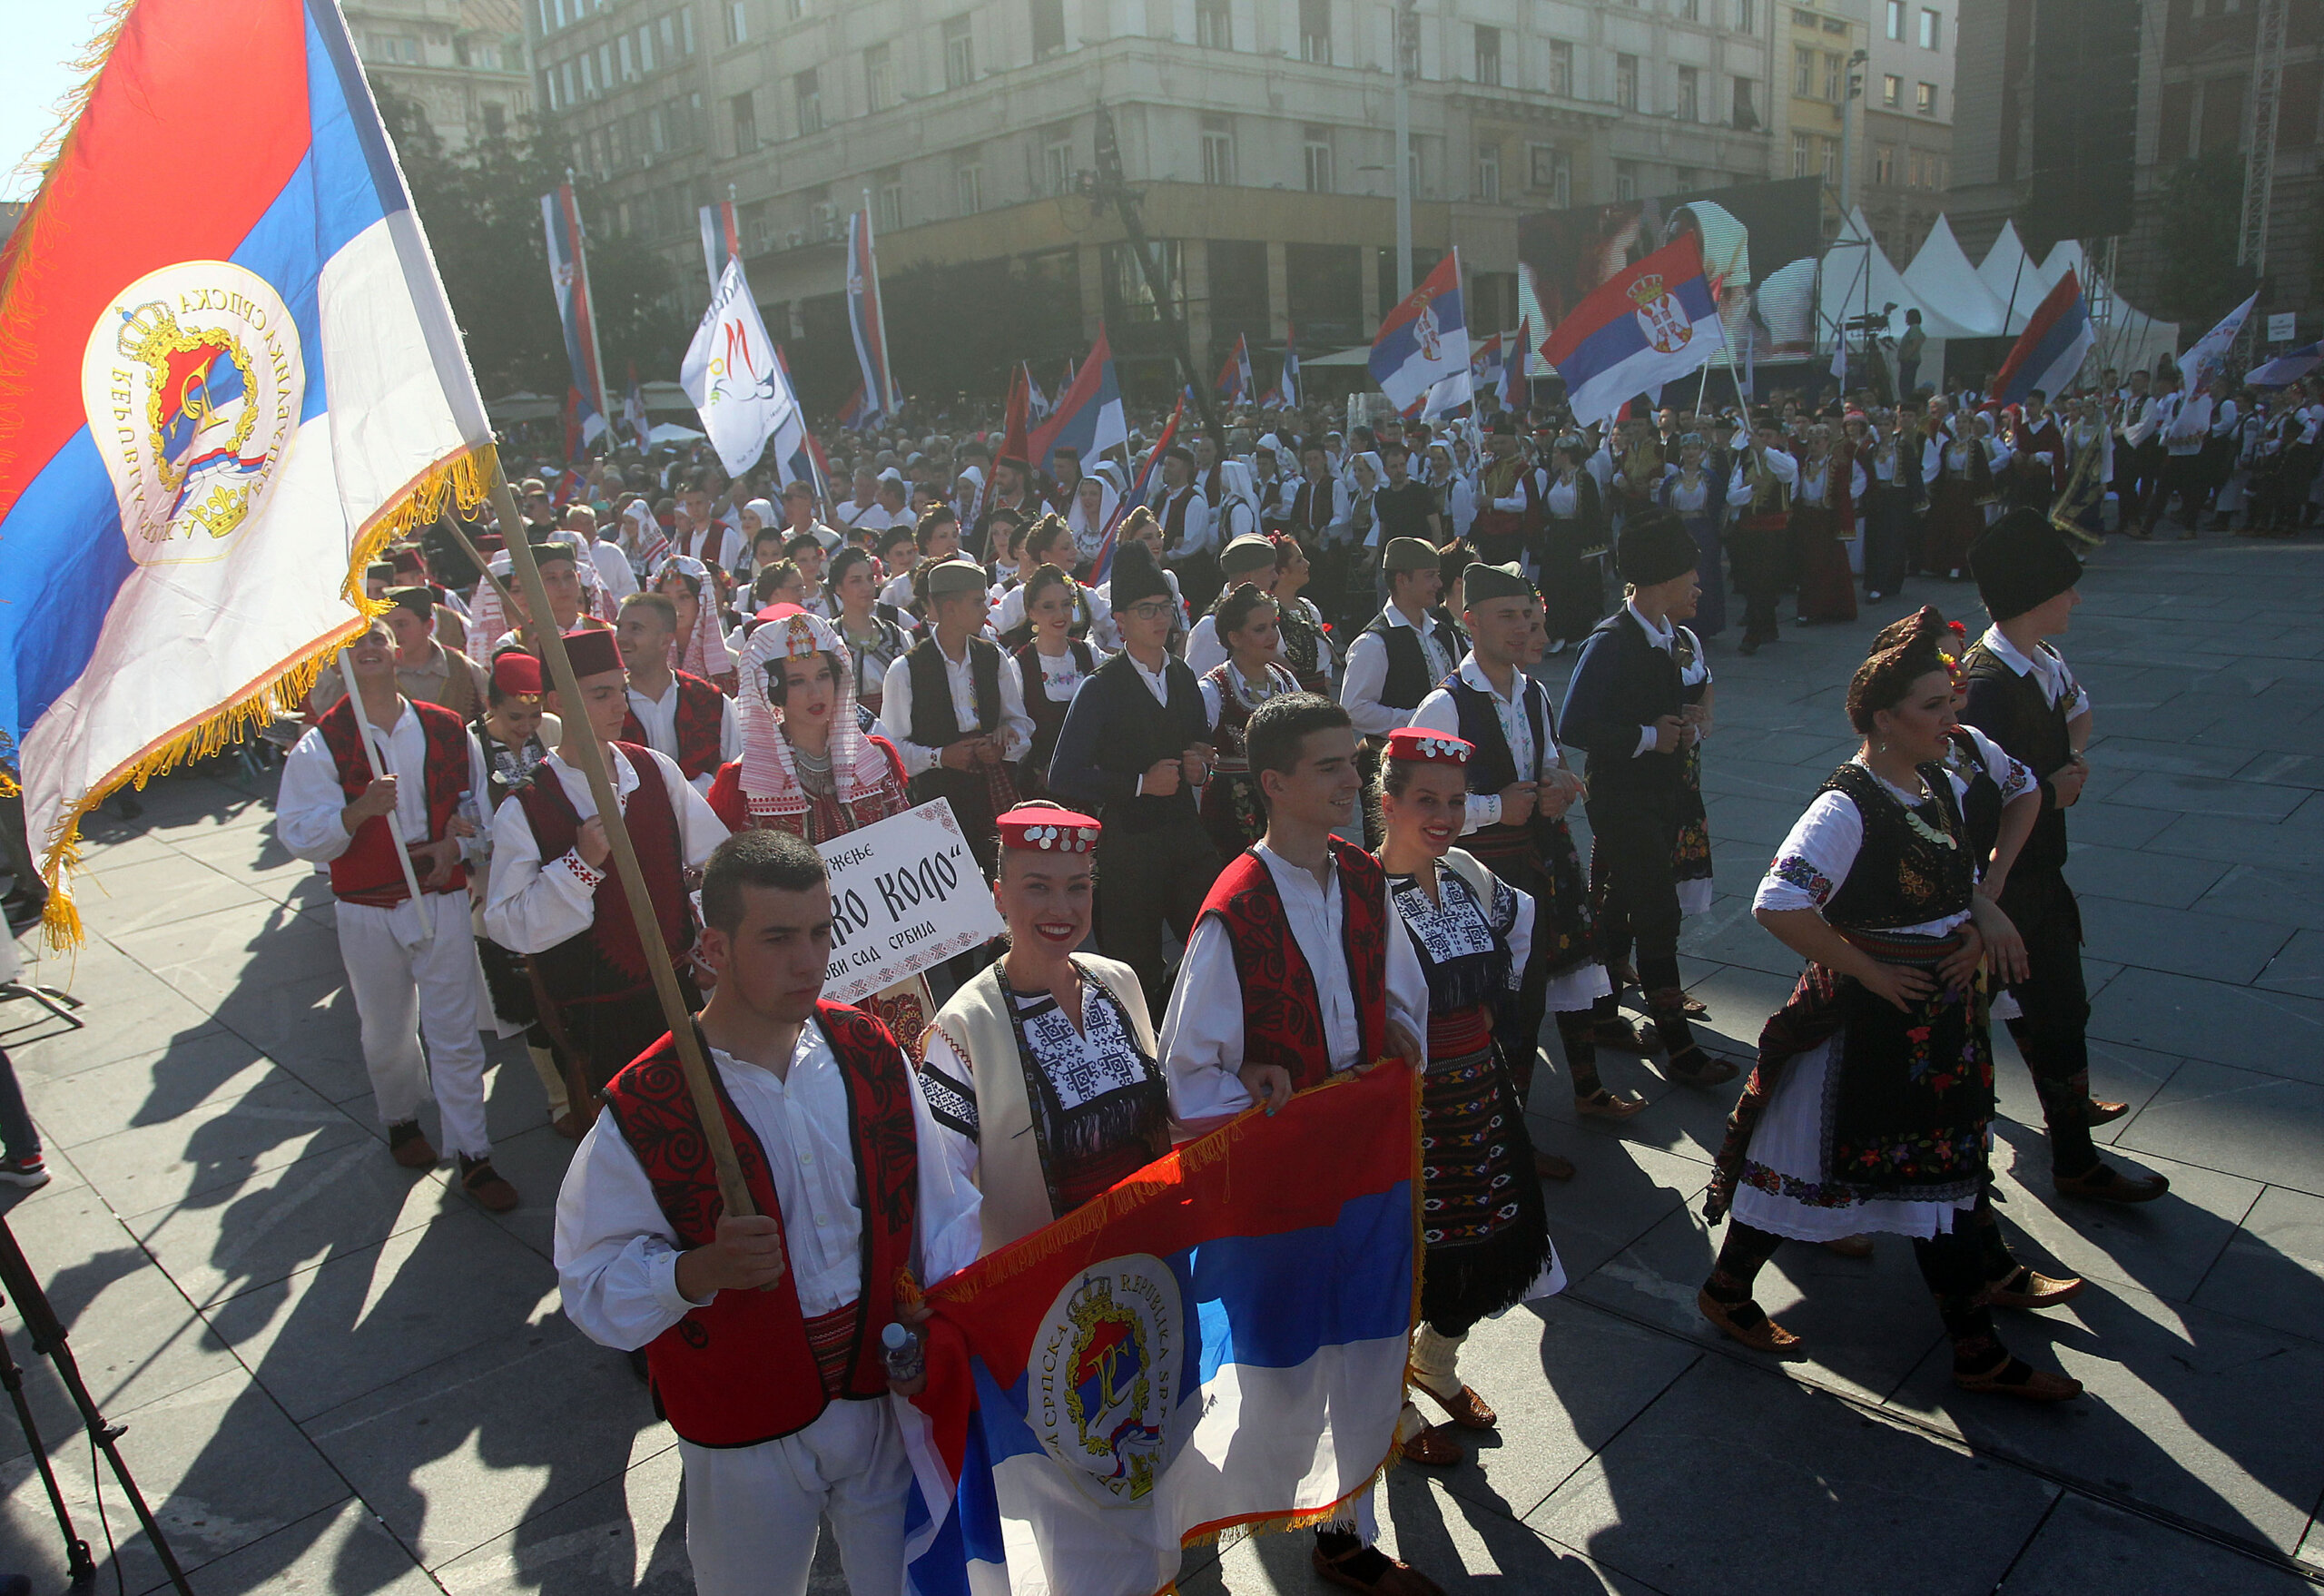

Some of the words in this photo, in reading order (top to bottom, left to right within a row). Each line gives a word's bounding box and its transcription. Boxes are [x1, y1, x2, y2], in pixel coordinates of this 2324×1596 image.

[852, 945, 881, 967] САД
[888, 920, 937, 950] СРБИЈА
[1119, 1273, 1169, 1360] REPUBLIKA
[1041, 1324, 1068, 1427] СРПСКА
